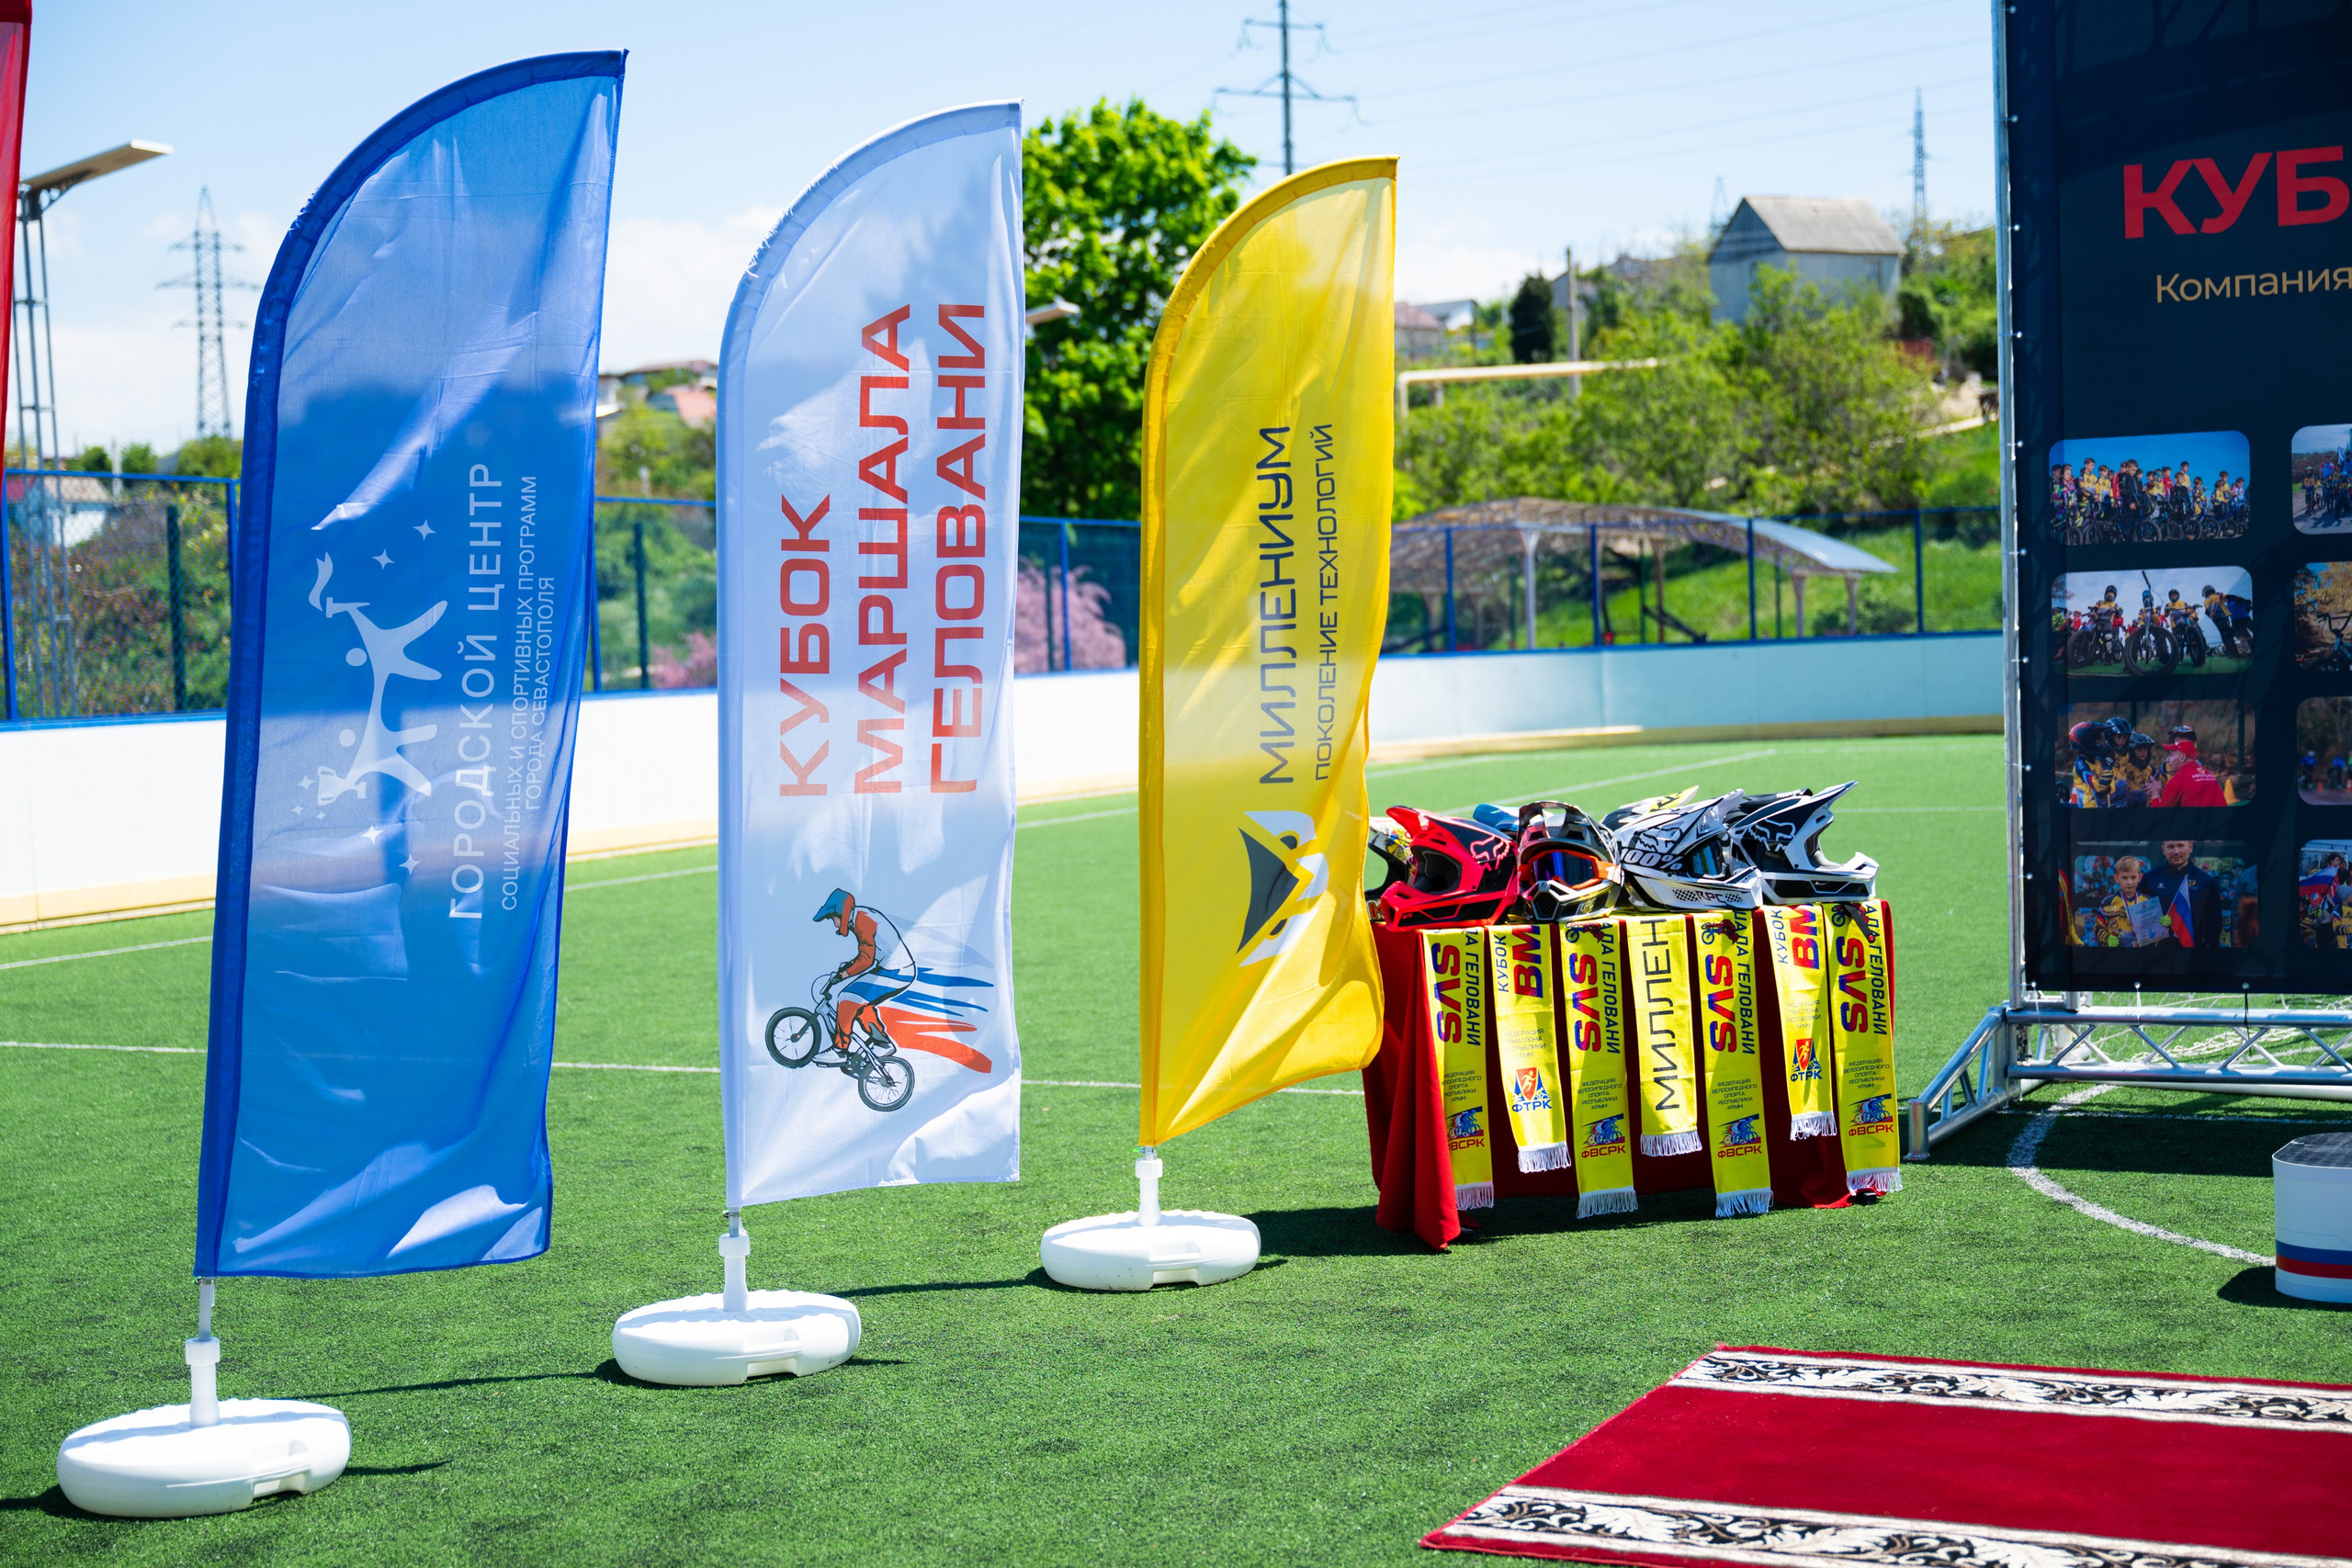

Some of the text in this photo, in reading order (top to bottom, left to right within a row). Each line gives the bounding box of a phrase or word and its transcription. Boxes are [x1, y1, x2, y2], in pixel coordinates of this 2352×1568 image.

[2123, 145, 2350, 240] КУБ
[2156, 266, 2352, 303] Компания
[854, 304, 910, 795] МАРШАЛА
[931, 304, 986, 794] ГЕЛОВАНИ
[780, 493, 830, 796] КУБОК
[1256, 426, 1297, 784] МИЛЛЕНИУМ
[1309, 423, 1339, 781] ПОКОЛЕНИЕ ТЕХНОЛОГИЙ
[449, 463, 504, 919] ГОРОДСКОЙ ЦЕНТР
[502, 476, 537, 911] СОЦИАЛЬНЫХ И СПОРТИВНЫХ ПРОГРАММ
[526, 576, 555, 811] ГОРОДА СЕВАСТОПОЛЯ
[1697, 888, 1725, 904] RPC
[1770, 909, 1788, 964] КУБОК
[1431, 942, 1462, 1043] SVS
[1465, 953, 1481, 1046] ГЕЛОВАНИ
[1494, 933, 1509, 992] КУБОК
[1569, 953, 1601, 1052] SVS
[1602, 961, 1621, 1054] ГЕЛОВАНИ
[1705, 954, 1736, 1053] SVS
[1737, 963, 1755, 1055] ГЕЛОВАНИ
[1836, 936, 1868, 1033] SVS
[1869, 945, 1887, 1035] ГЕЛОВАНИ
[1640, 919, 1679, 1111] МИЛЛЕН
[1511, 1100, 1553, 1112] ФТРК
[1790, 1069, 1823, 1082] ФТРК
[1581, 1145, 1626, 1158] ФВСРК
[1717, 1145, 1762, 1158] ФВСРК
[1849, 1124, 1894, 1136] ФВСРК
